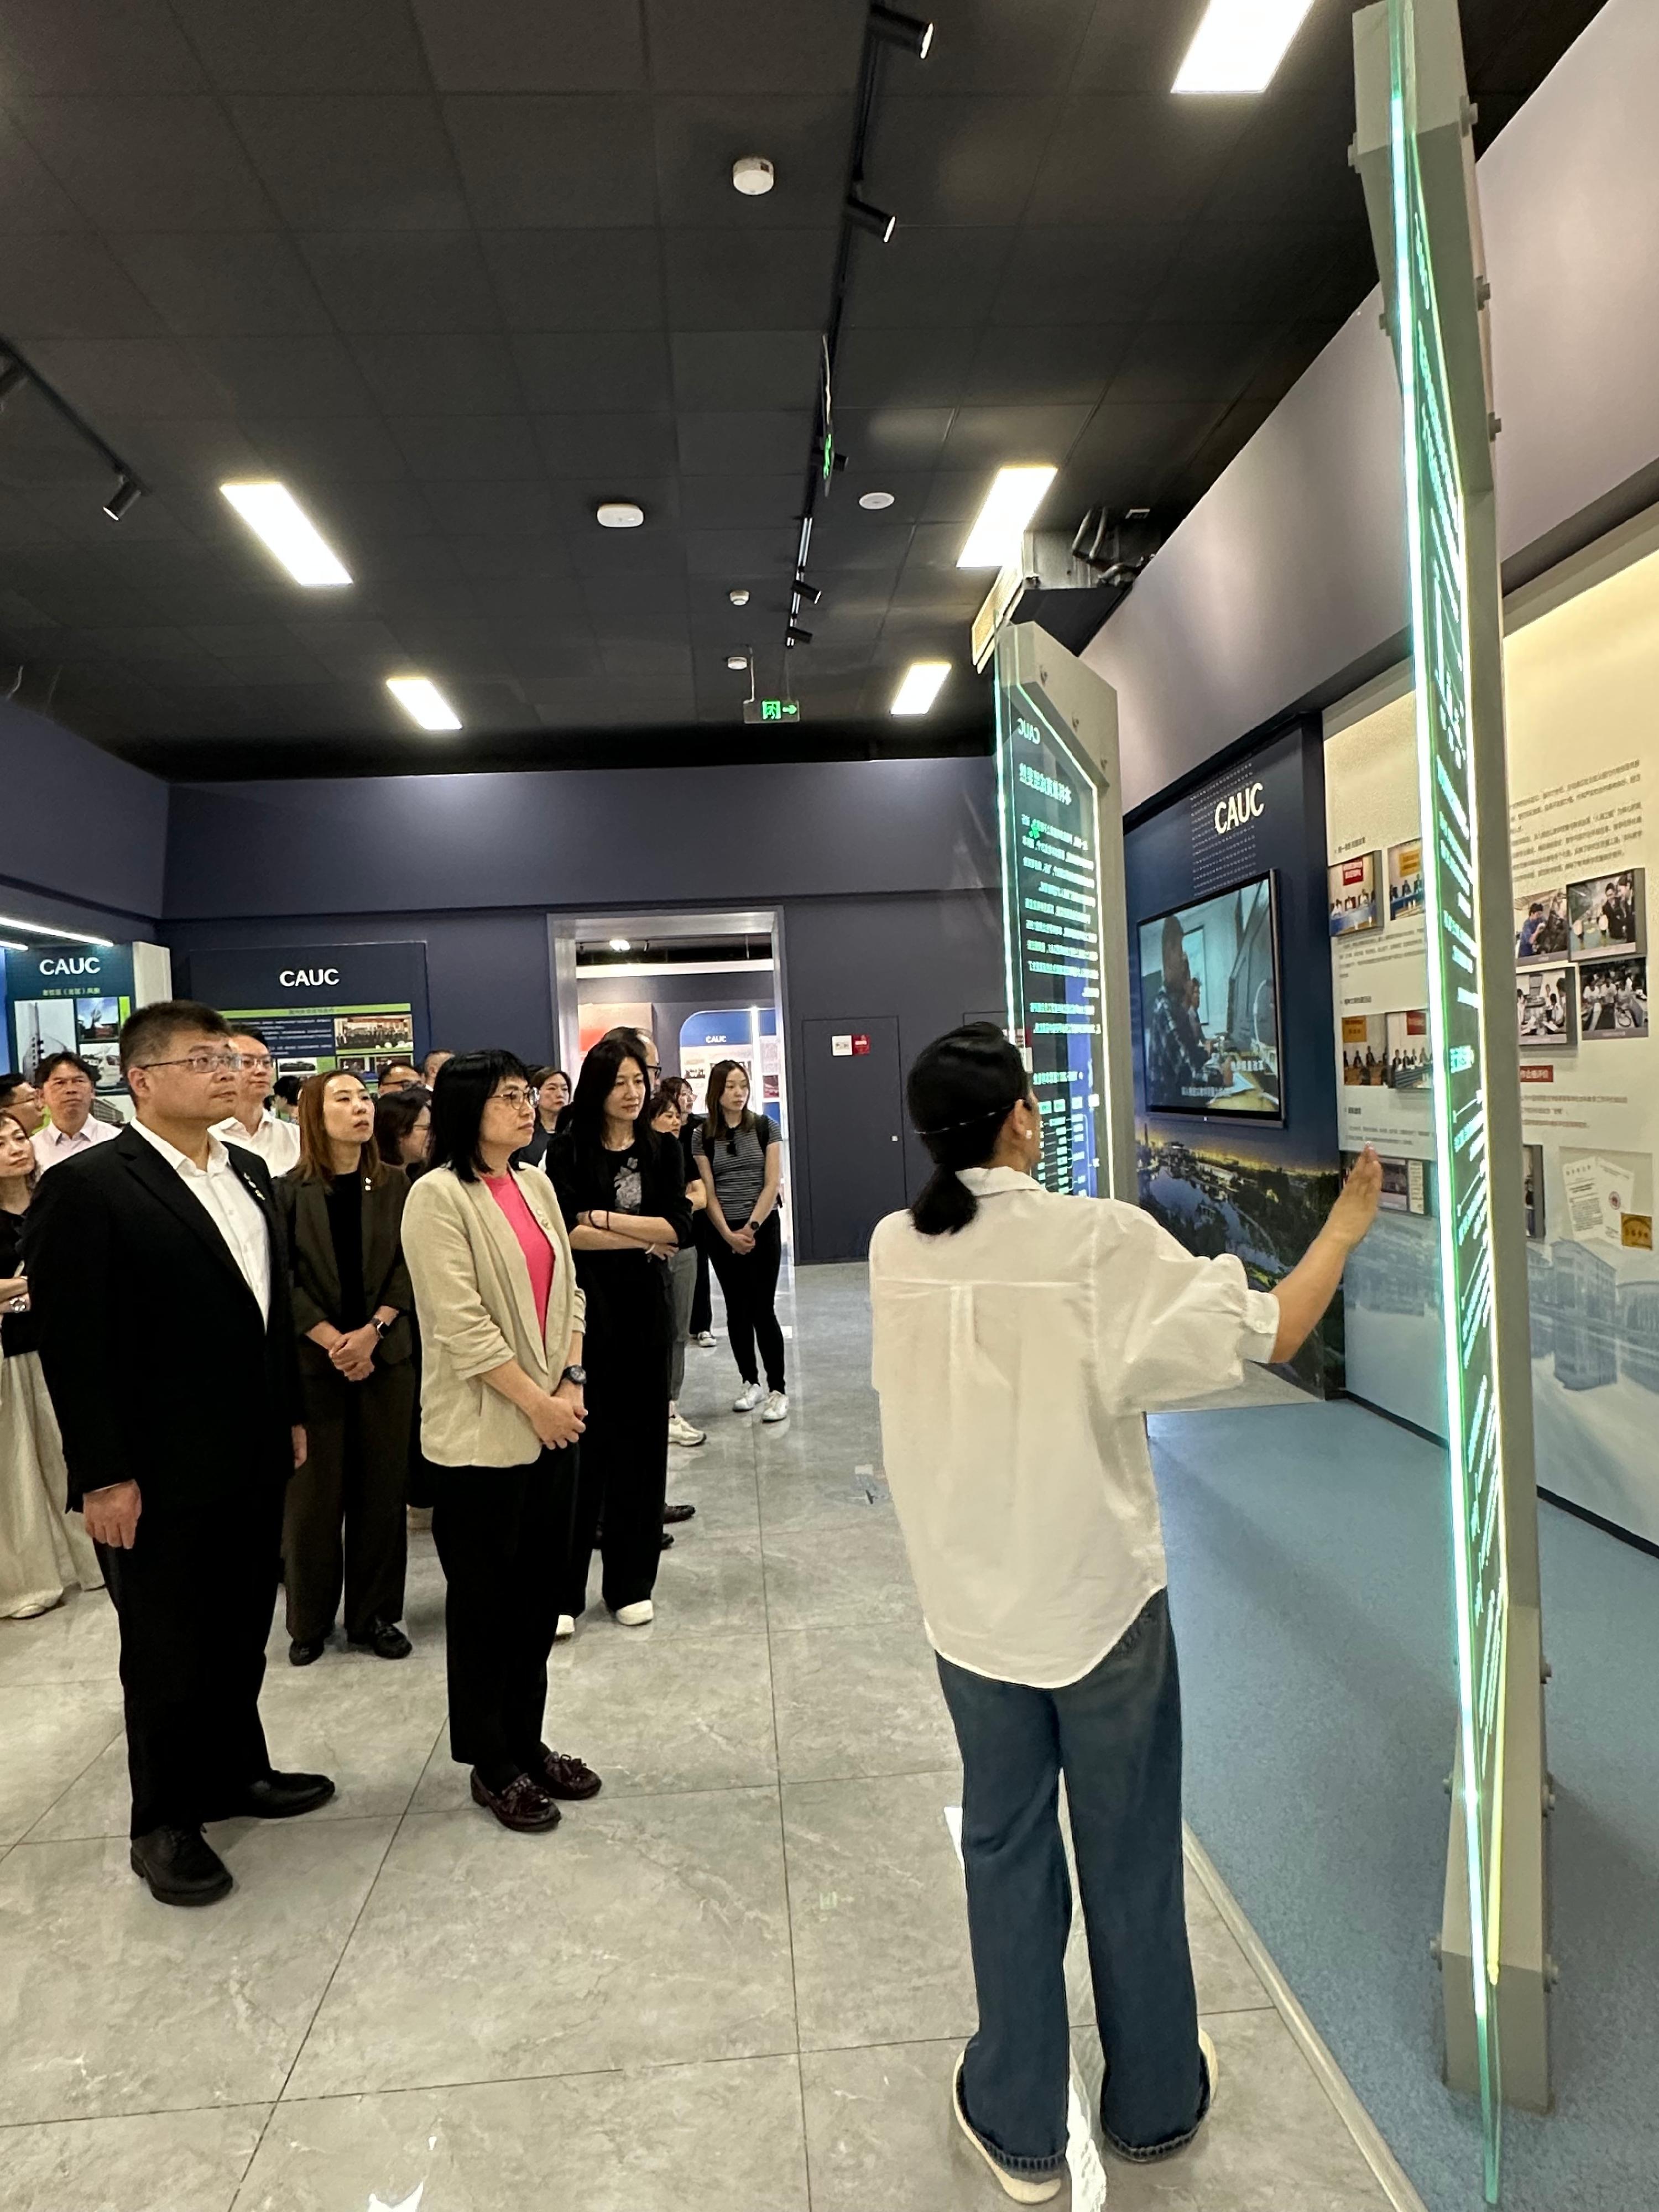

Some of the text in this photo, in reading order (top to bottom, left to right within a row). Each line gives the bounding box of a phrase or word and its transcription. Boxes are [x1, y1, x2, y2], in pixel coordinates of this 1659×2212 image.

[1214, 782, 1264, 834] CAUC
[39, 957, 101, 975] CAUC
[279, 968, 340, 987] CAUC
